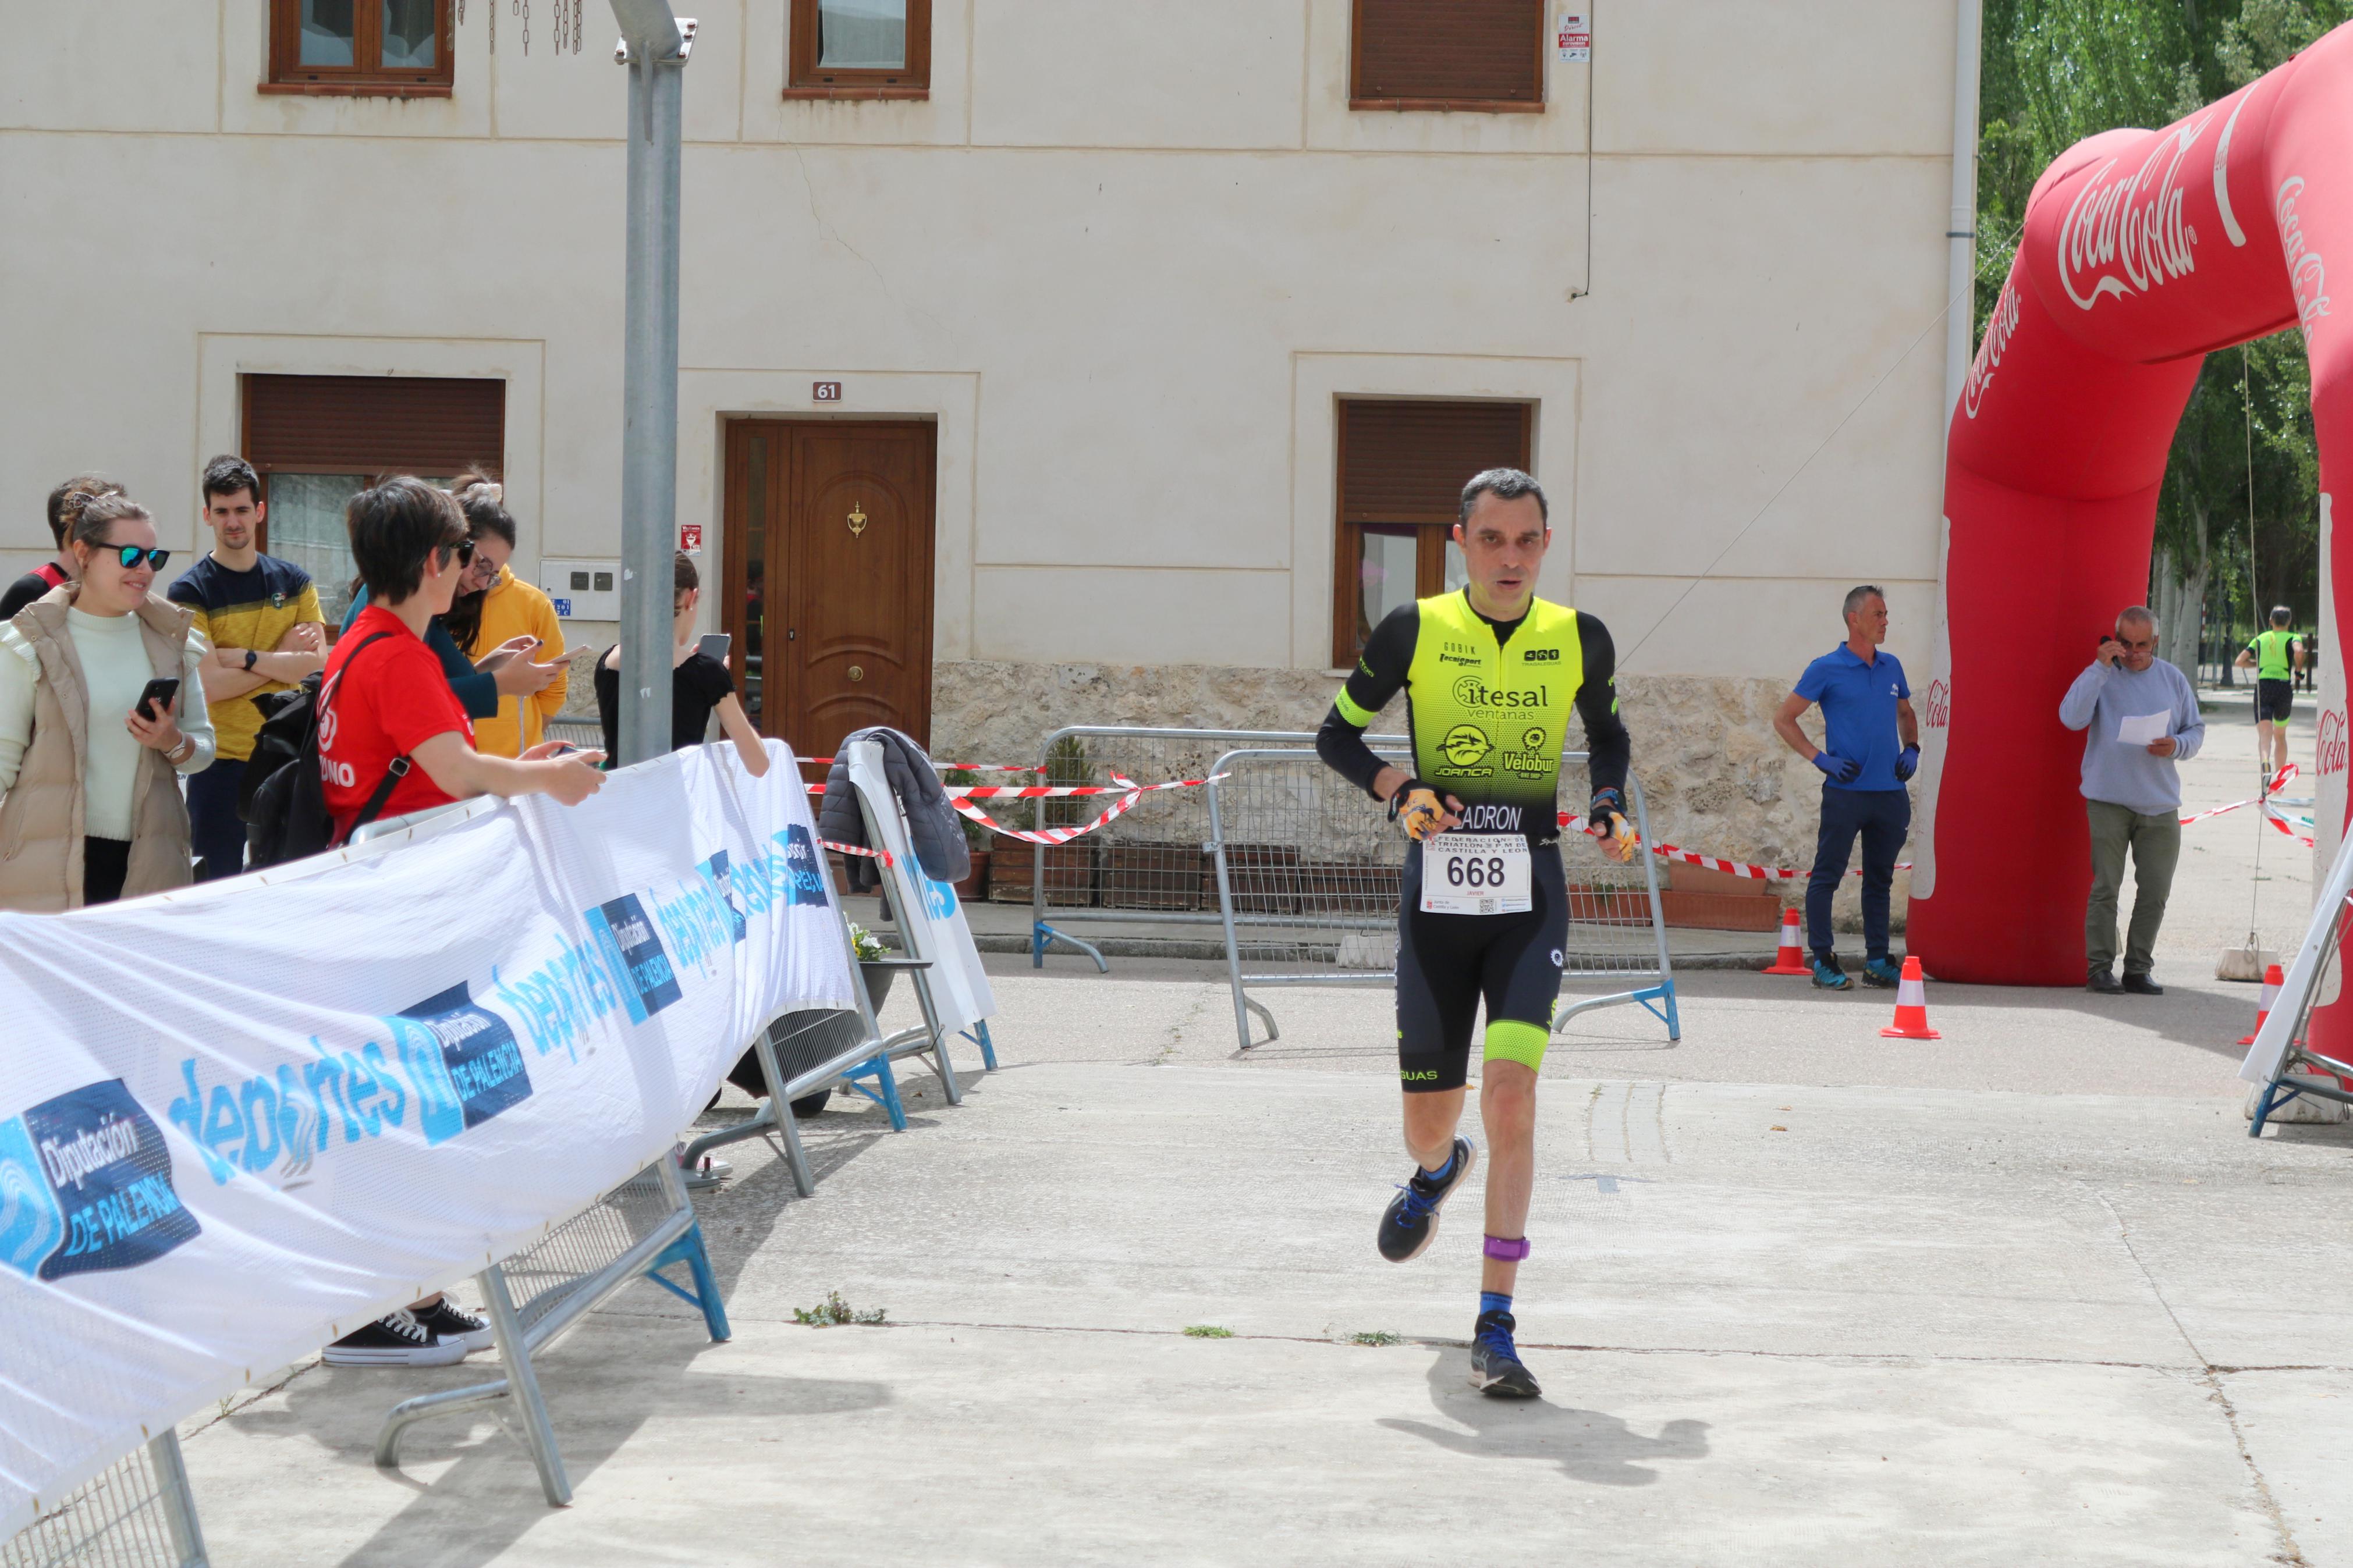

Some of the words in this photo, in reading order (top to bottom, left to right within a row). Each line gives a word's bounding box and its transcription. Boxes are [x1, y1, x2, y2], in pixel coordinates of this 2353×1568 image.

[2058, 112, 2213, 310] Coca-Cola
[818, 385, 835, 399] 61
[1444, 642, 1475, 655] GOBIK
[1468, 682, 1548, 707] itesal
[1467, 709, 1534, 720] ventanas
[1435, 767, 1493, 777] JOANCA
[1504, 753, 1553, 772] Velobur
[1447, 856, 1505, 888] 668
[451, 1065, 476, 1101] DE
[468, 1040, 523, 1094] PALENCIA
[41, 1112, 139, 1191] Diputación
[62, 1206, 102, 1257] DE
